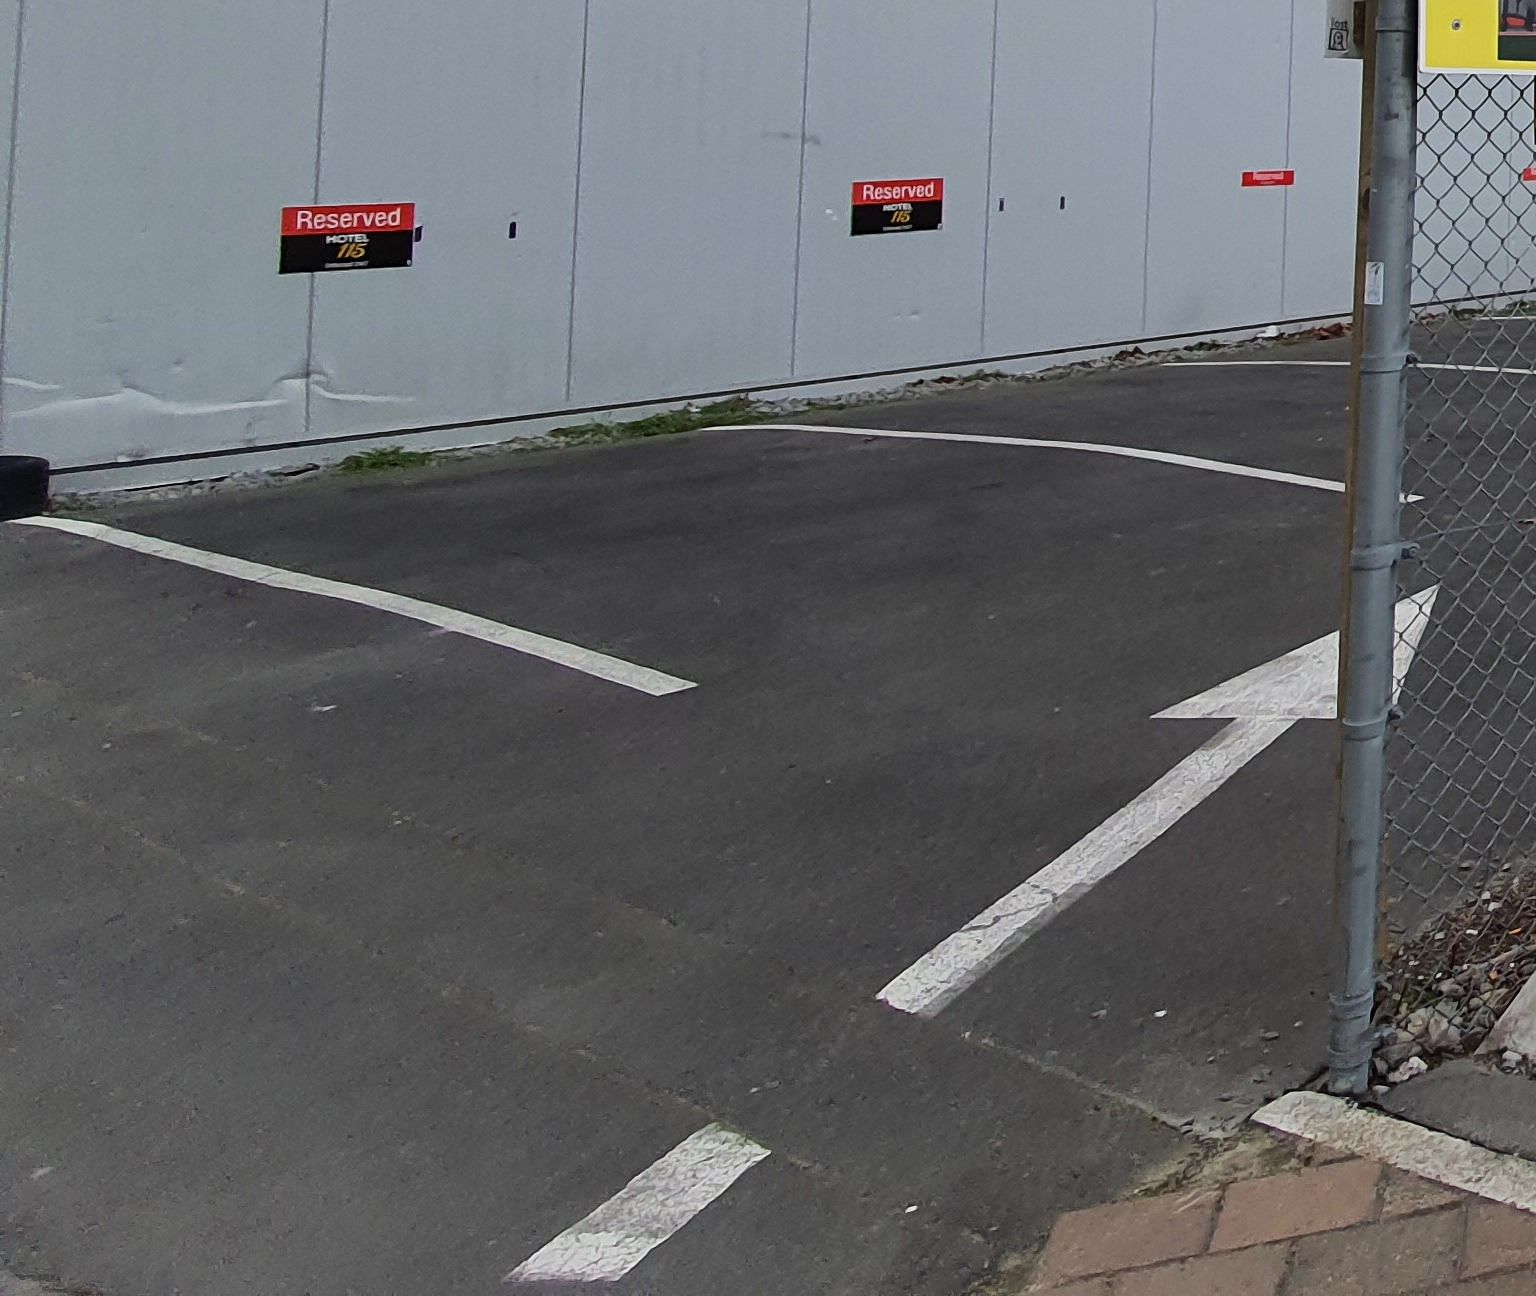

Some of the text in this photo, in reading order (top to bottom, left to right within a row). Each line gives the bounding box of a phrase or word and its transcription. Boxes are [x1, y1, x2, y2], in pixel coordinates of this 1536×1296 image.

[863, 182, 935, 201] Reserved
[296, 208, 401, 230] Reserved
[891, 211, 911, 223] 115
[327, 234, 370, 244] HOTEL
[336, 243, 368, 259] 115
